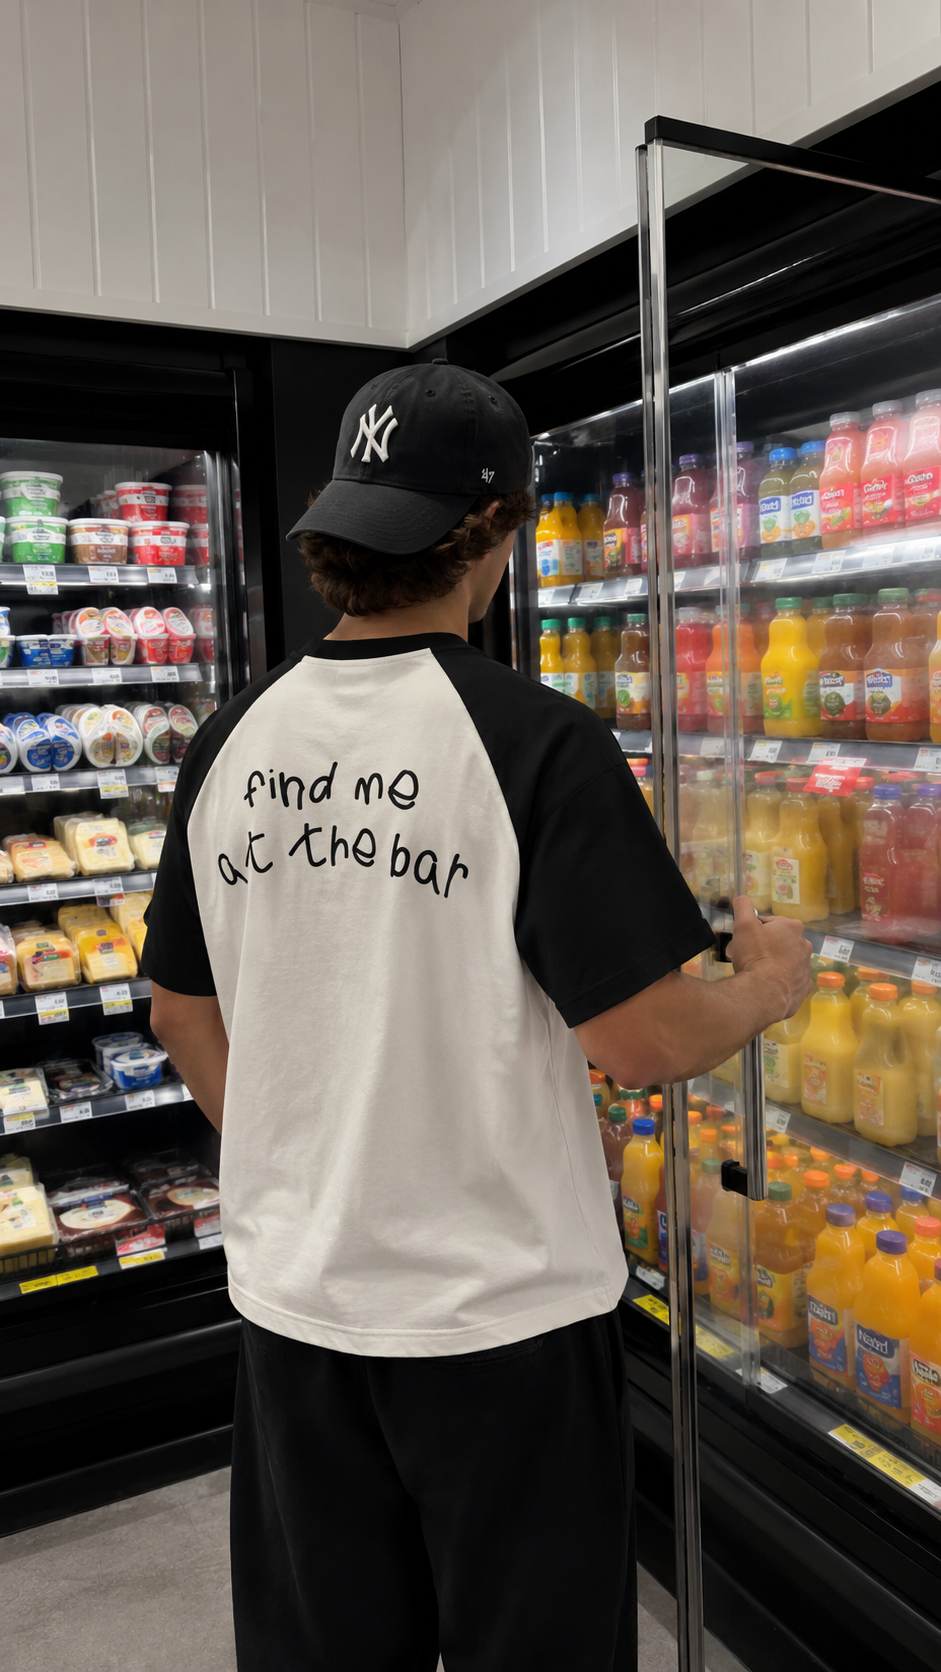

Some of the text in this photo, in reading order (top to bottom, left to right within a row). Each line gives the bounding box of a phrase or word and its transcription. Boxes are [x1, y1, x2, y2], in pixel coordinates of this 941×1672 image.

[350, 403, 399, 463] NY
[243, 761, 419, 811] find me
[217, 822, 469, 899] at the bar
